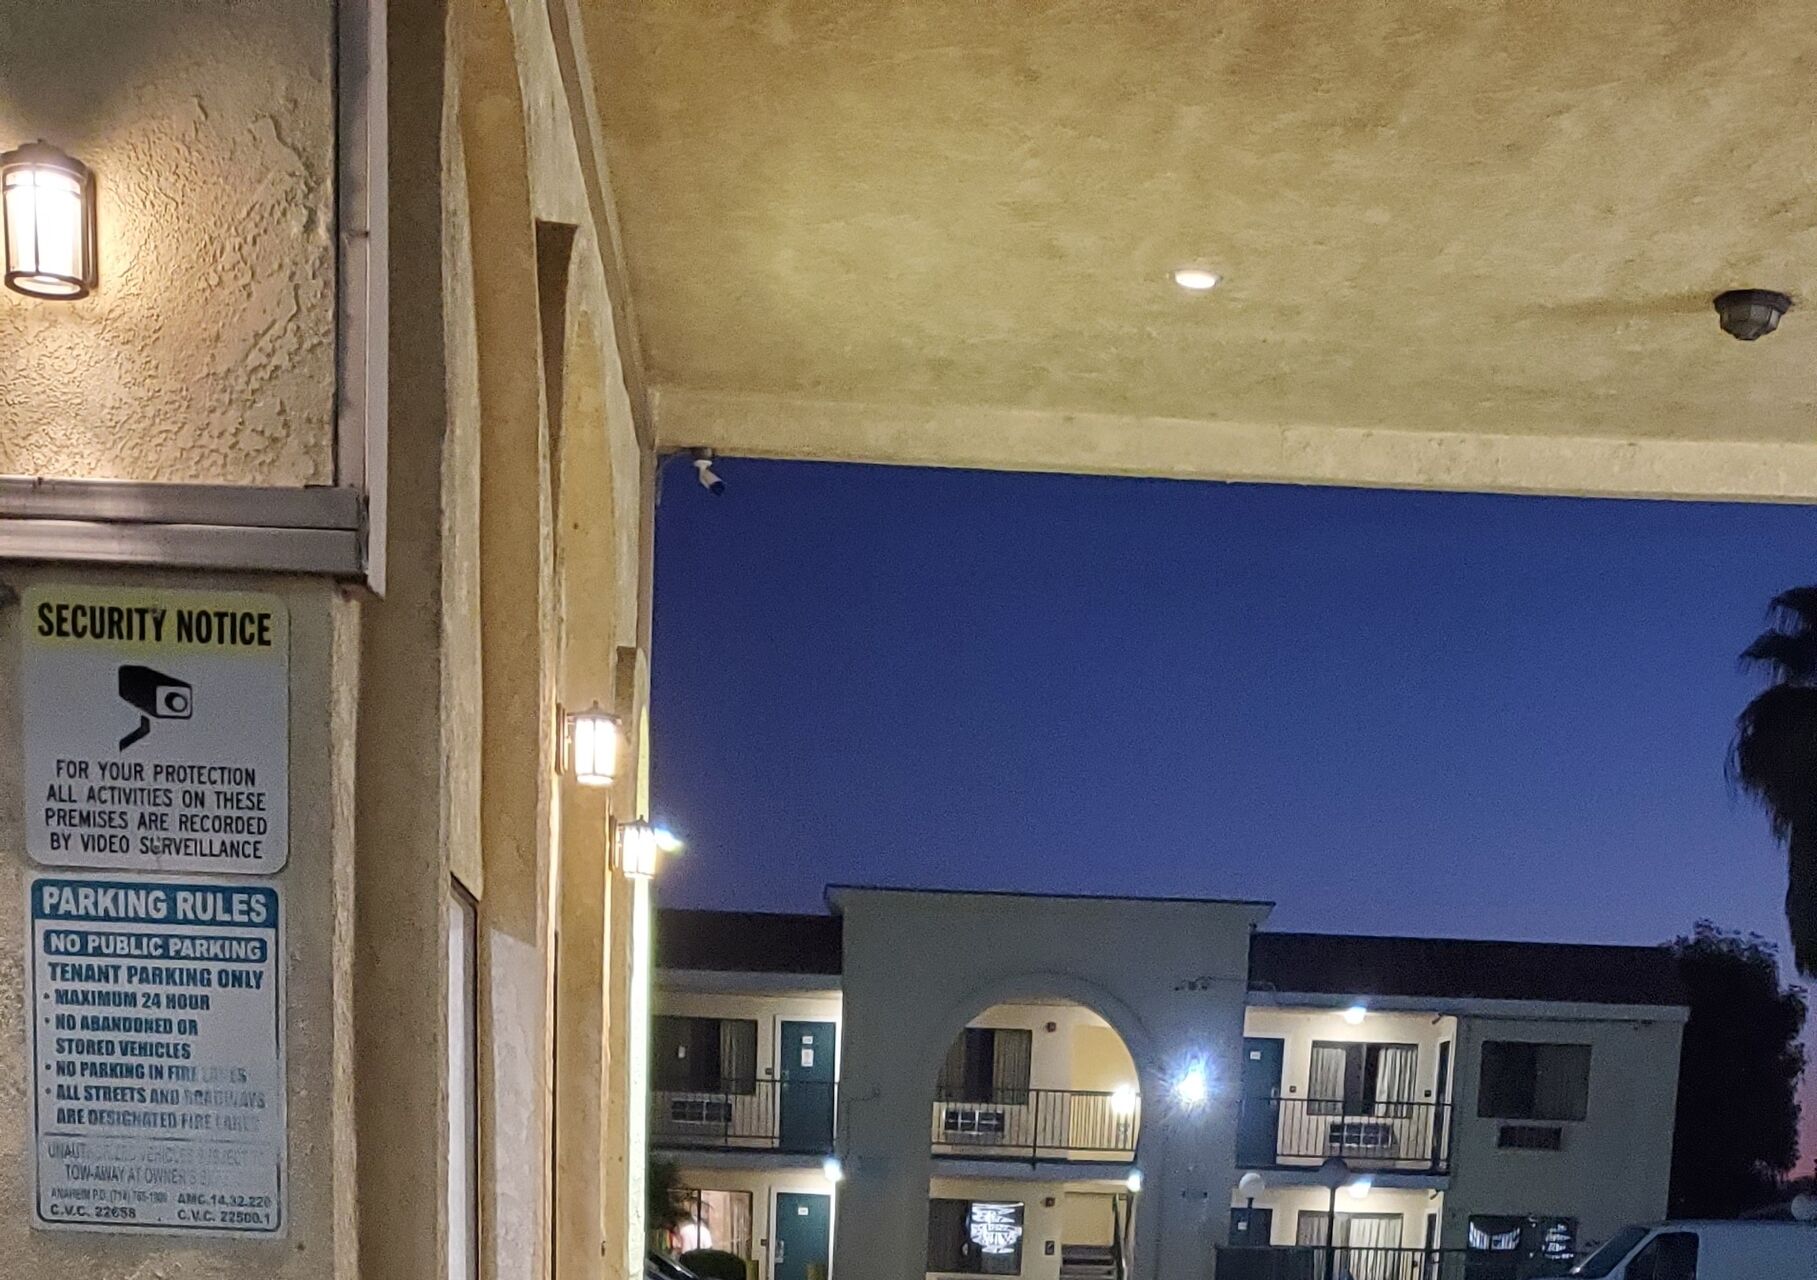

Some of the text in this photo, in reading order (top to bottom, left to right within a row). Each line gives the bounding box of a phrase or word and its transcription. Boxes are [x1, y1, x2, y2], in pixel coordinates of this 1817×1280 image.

[37, 602, 272, 646] SECURITY NOTICE
[56, 759, 256, 786] FOR YOUR PROTECTION
[46, 783, 266, 812] ALL ACTIVITIES ON THESE
[45, 808, 268, 835] PREMISES ARE RECORDED
[50, 832, 263, 859] BY VIDEO SURVEILLANCE
[42, 886, 267, 924] PARKING RULES
[50, 933, 262, 960] NO PUBLIC PARKING
[48, 962, 264, 990] TENANT PARKING ONLY
[54, 988, 210, 1010] MAXIMUM 24 HOUR
[55, 1013, 198, 1035] NO ABANDONED OR
[55, 1038, 191, 1060] STORED VEHICLES
[55, 1061, 76, 1077] NO
[80, 1062, 145, 1079] PARKING
[149, 1064, 164, 1081] IN
[202, 1067, 247, 1083] LAES
[57, 1084, 80, 1100] ALL
[84, 1085, 146, 1103] STREETS
[150, 1089, 179, 1105] AND
[57, 1108, 85, 1124] ARE
[88, 1109, 177, 1129] DESIGNATED
[181, 1113, 212, 1130] FIRE
[65, 1164, 124, 1182] TOW-AWAY
[127, 1168, 142, 1182] AT
[144, 1168, 197, 1185] OWNERS
[51, 1204, 90, 1217] C.V.C.
[177, 1209, 216, 1222] C.V.C.
[220, 1211, 270, 1225] 22500.1
